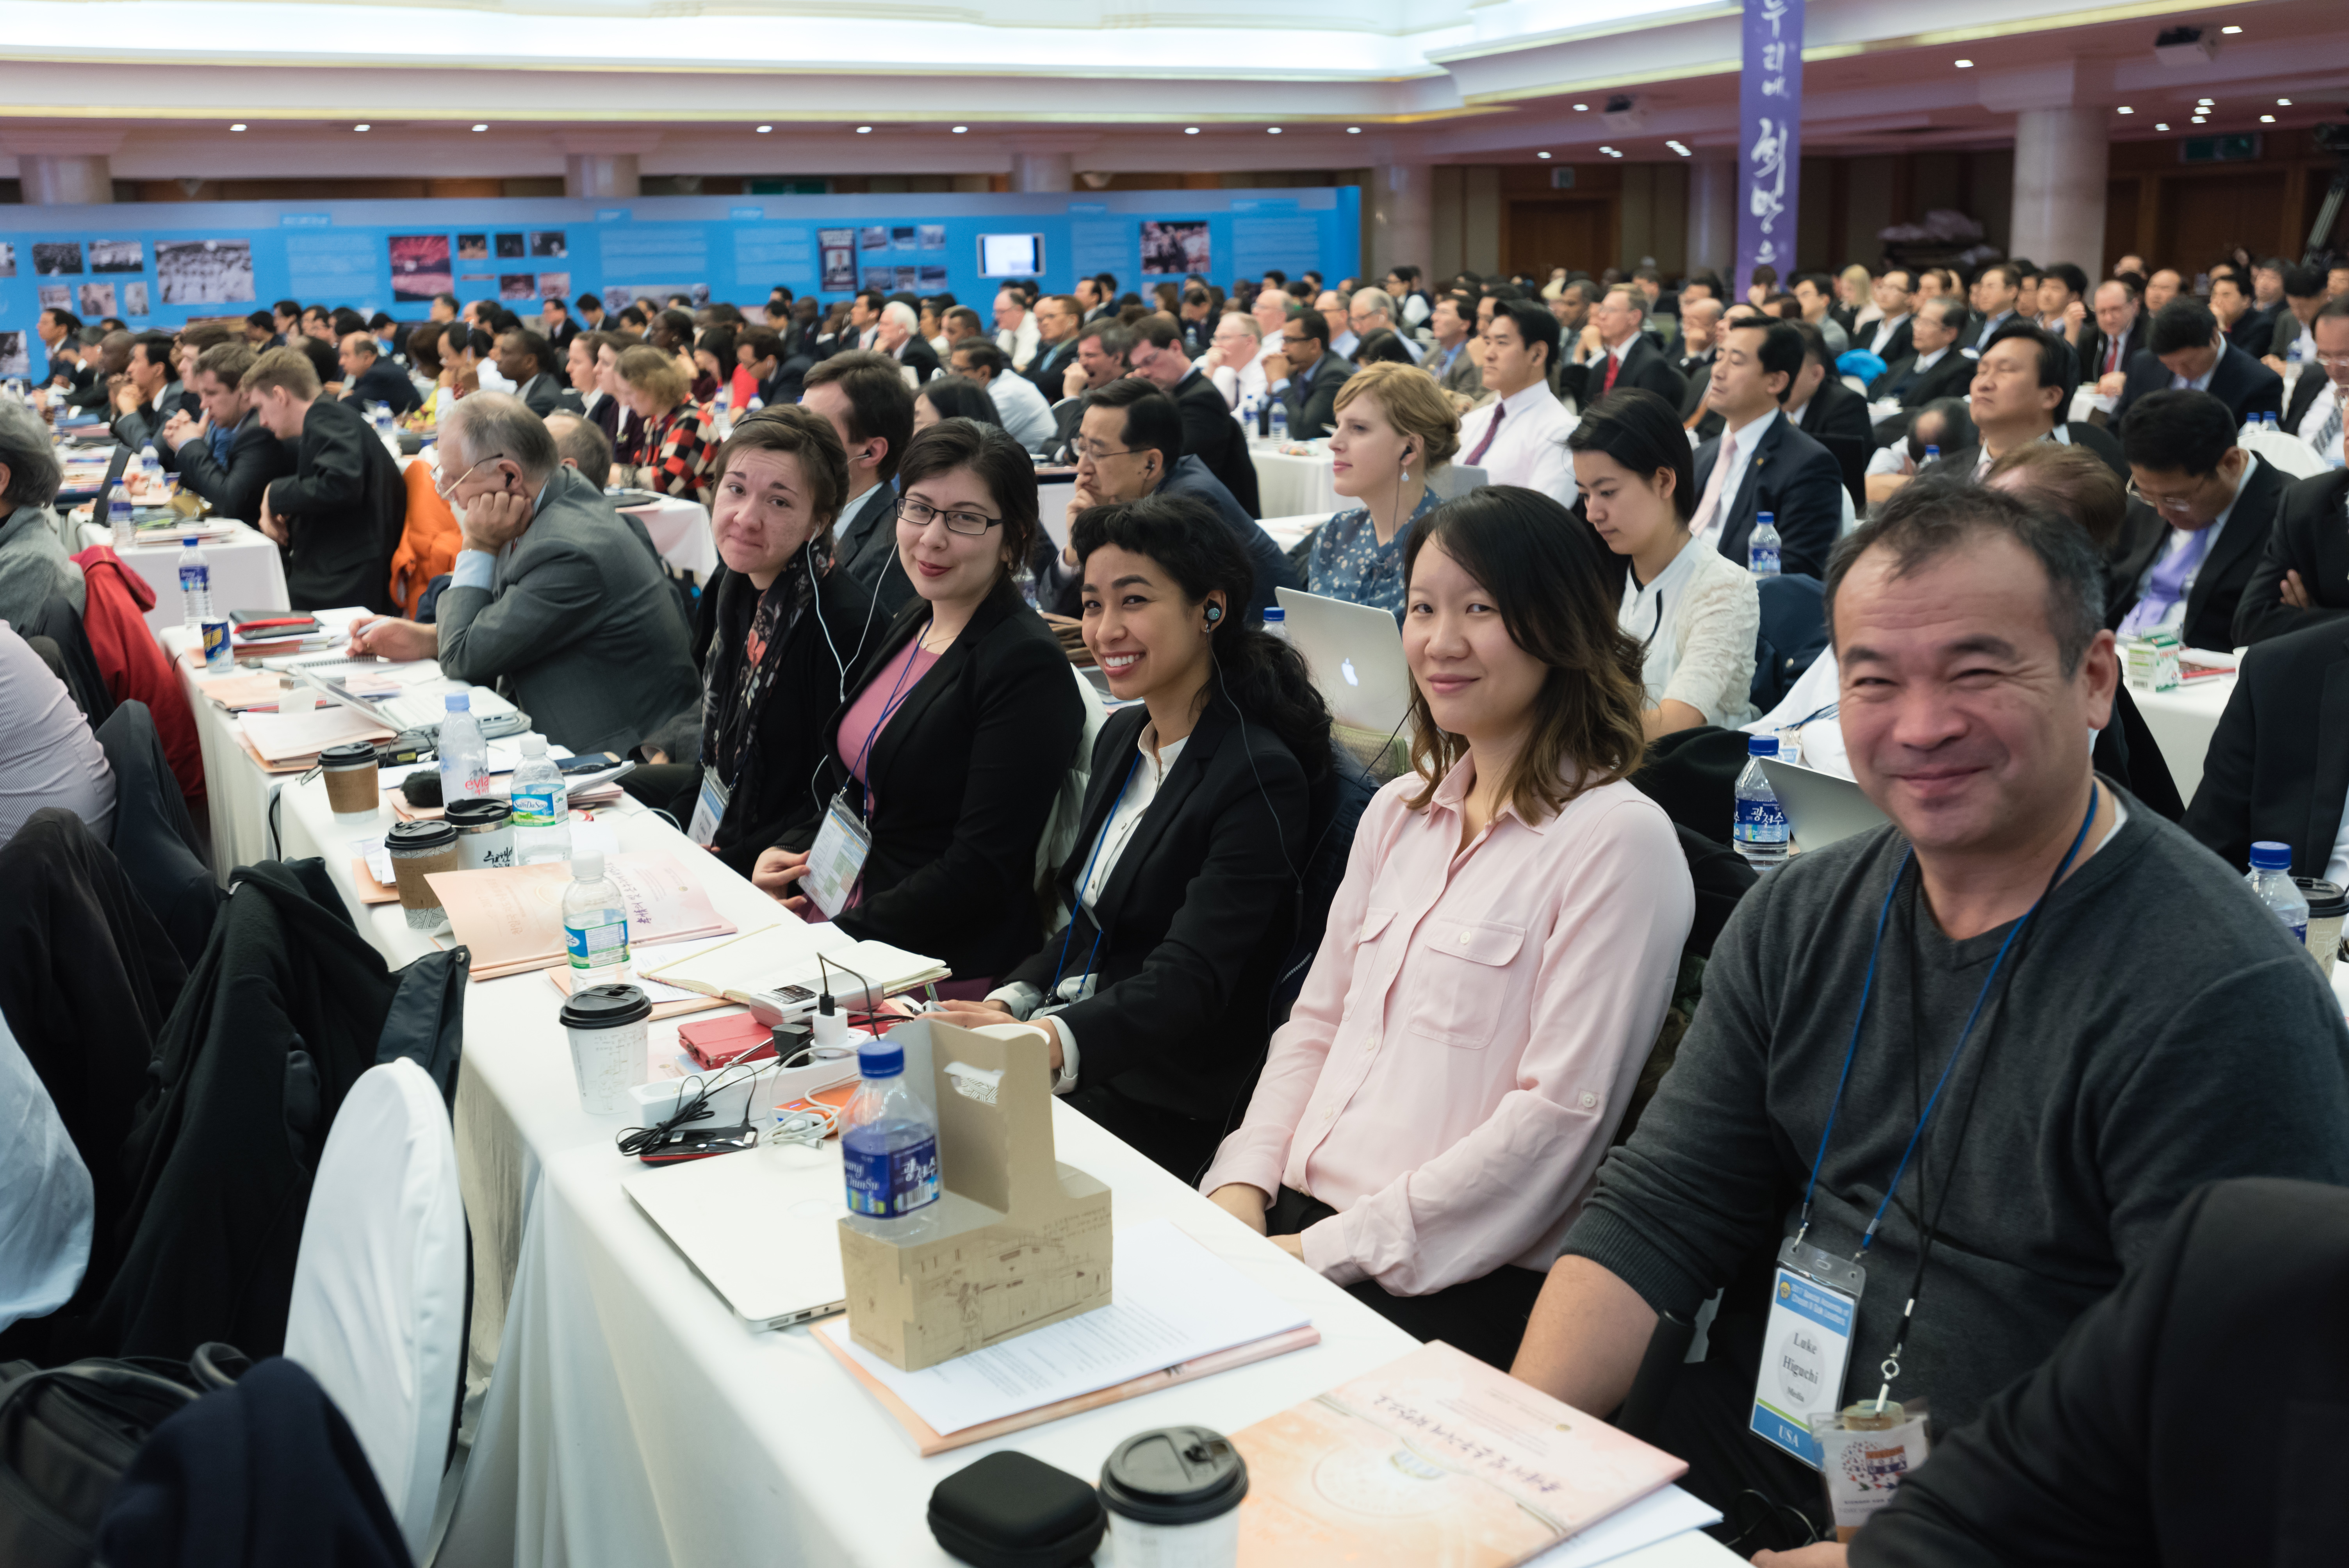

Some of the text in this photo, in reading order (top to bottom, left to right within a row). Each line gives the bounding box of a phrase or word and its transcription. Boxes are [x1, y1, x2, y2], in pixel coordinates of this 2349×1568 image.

[1751, 806, 1784, 828] 광천수
[901, 1157, 937, 1187] 광천수
[1793, 1332, 1818, 1355] Luke
[1783, 1355, 1819, 1385] Higuchi
[1779, 1424, 1799, 1448] USA
